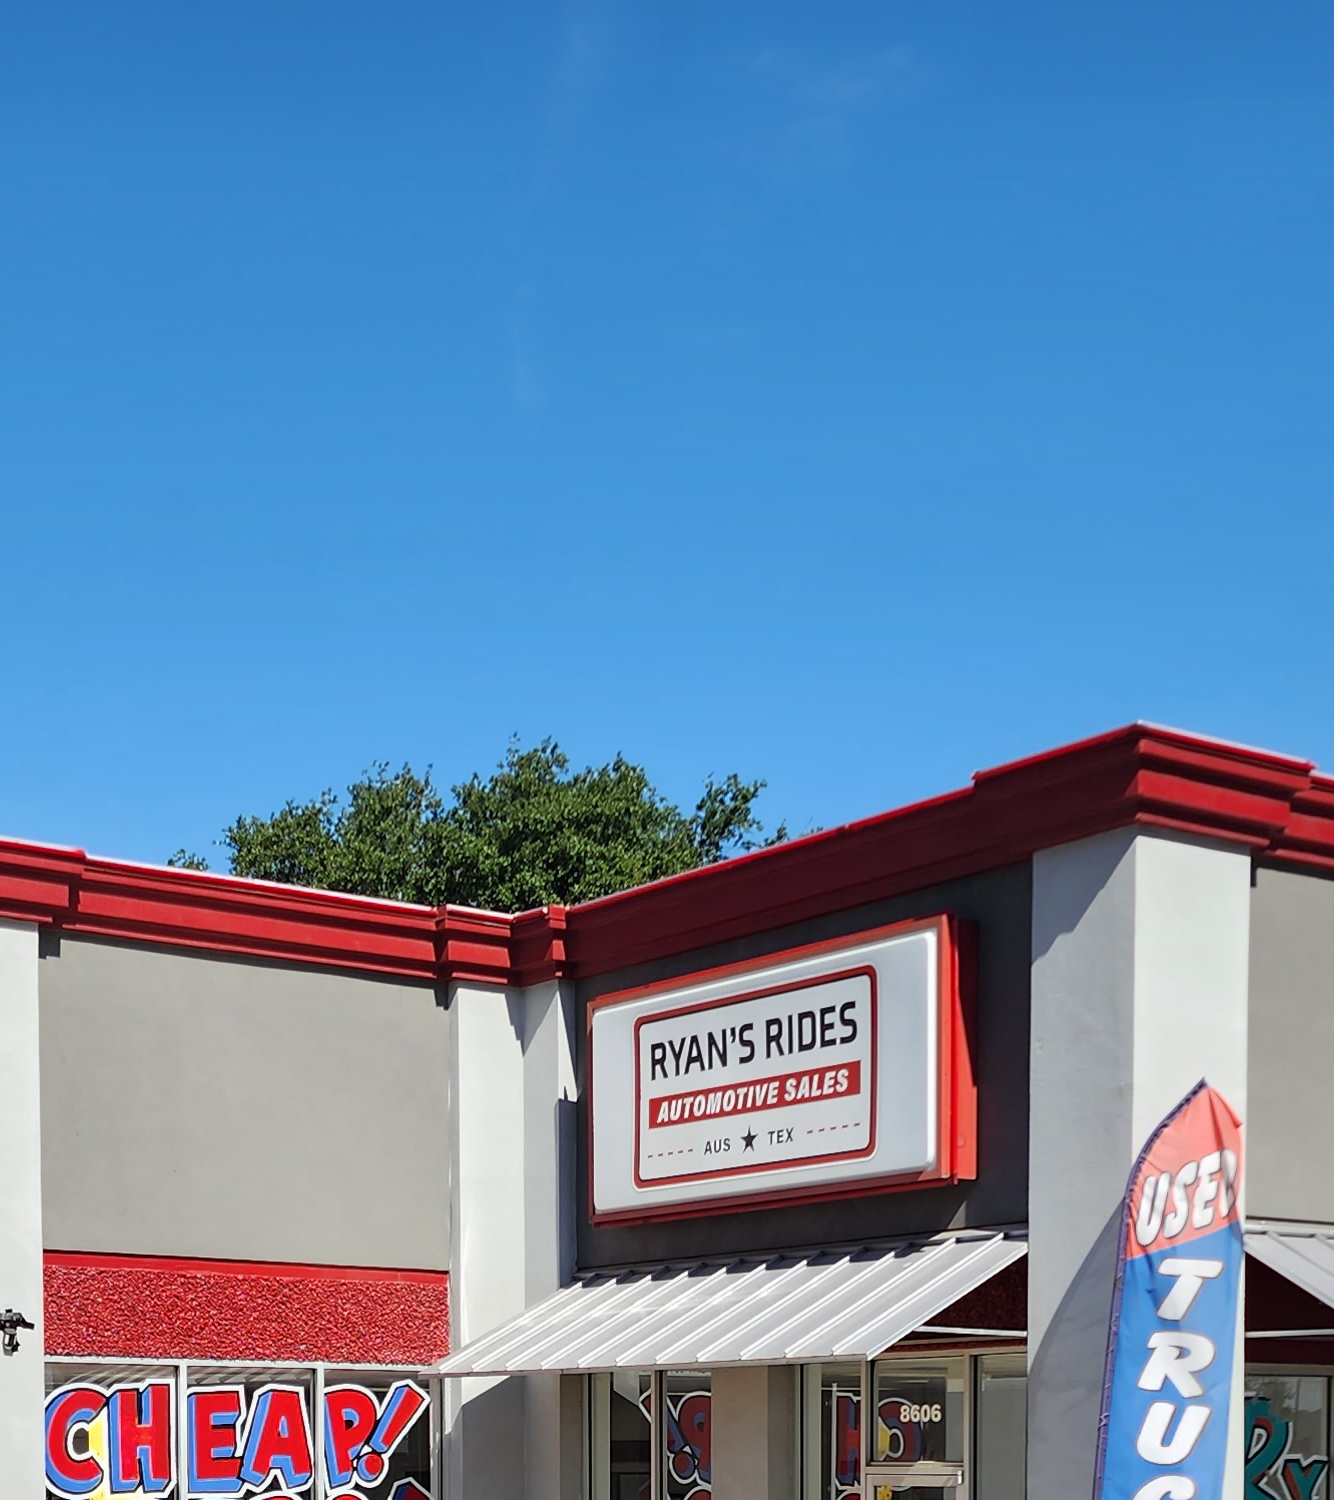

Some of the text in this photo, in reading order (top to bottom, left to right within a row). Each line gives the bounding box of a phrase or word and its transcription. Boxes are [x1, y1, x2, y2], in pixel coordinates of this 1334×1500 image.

[649, 1000, 858, 1081] RYAN'S RIDES
[656, 1068, 850, 1124] AUTOMOTIVE SALES
[704, 1127, 794, 1155] AUS TEX
[44, 1379, 432, 1500] CHEAP!
[899, 1404, 942, 1423] 8606
